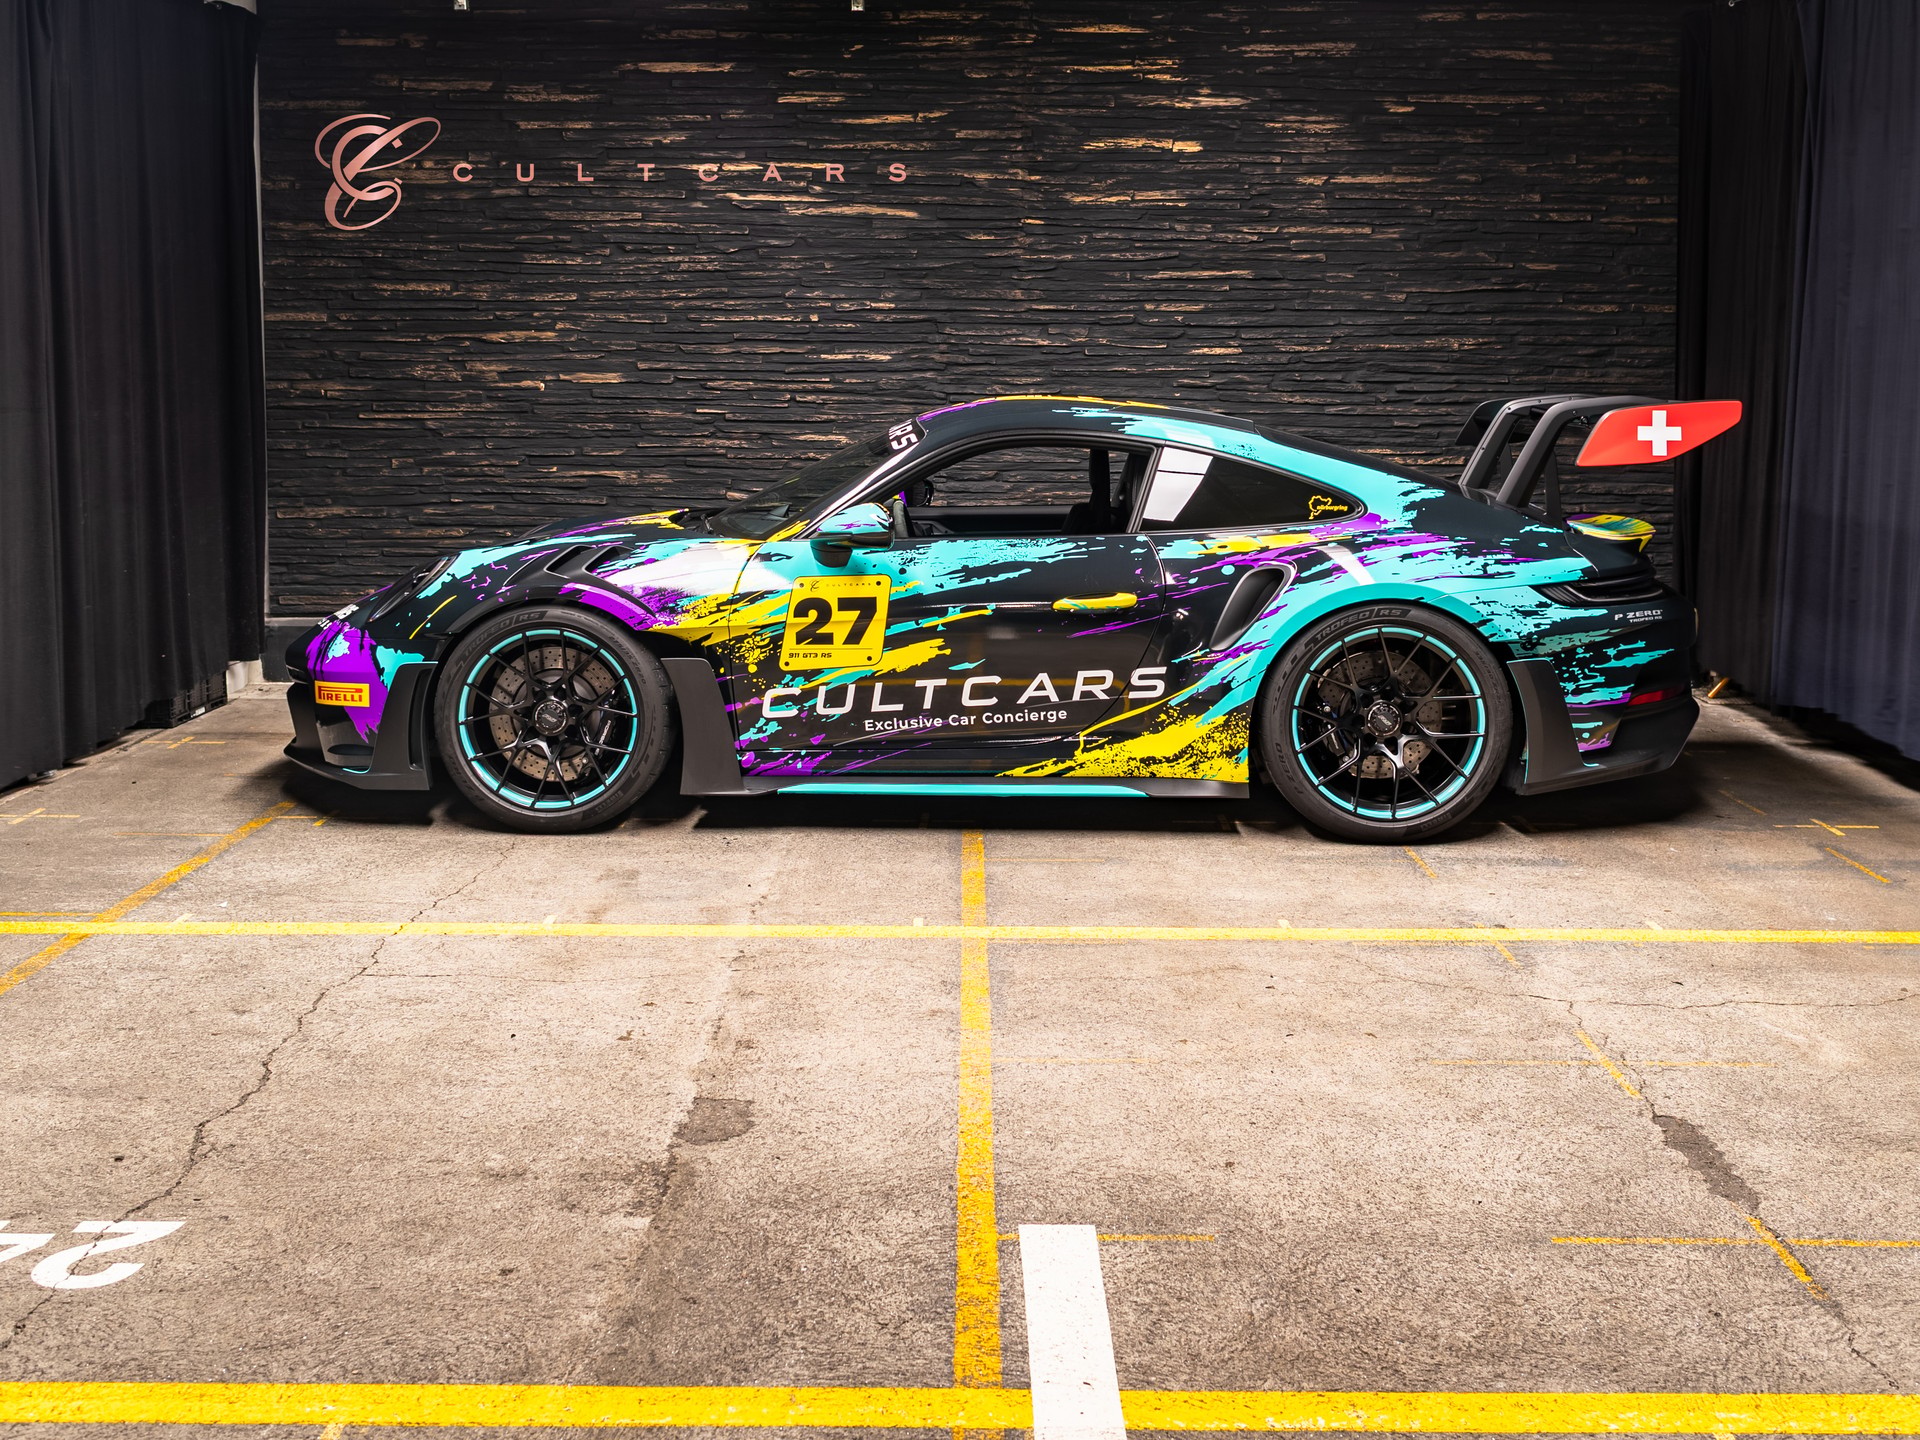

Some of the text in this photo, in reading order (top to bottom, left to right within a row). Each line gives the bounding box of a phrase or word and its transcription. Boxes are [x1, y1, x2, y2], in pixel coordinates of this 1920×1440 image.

[452, 163, 908, 183] CULTCARS
[519, 612, 541, 621] RS
[793, 596, 878, 646] 27
[1315, 611, 1370, 641] TROFEO
[1614, 609, 1662, 621] P ZERO
[318, 685, 363, 703] PIRELLI
[761, 666, 1168, 719] CULTCARS
[864, 707, 1068, 731] Exclusive Car Concierge
